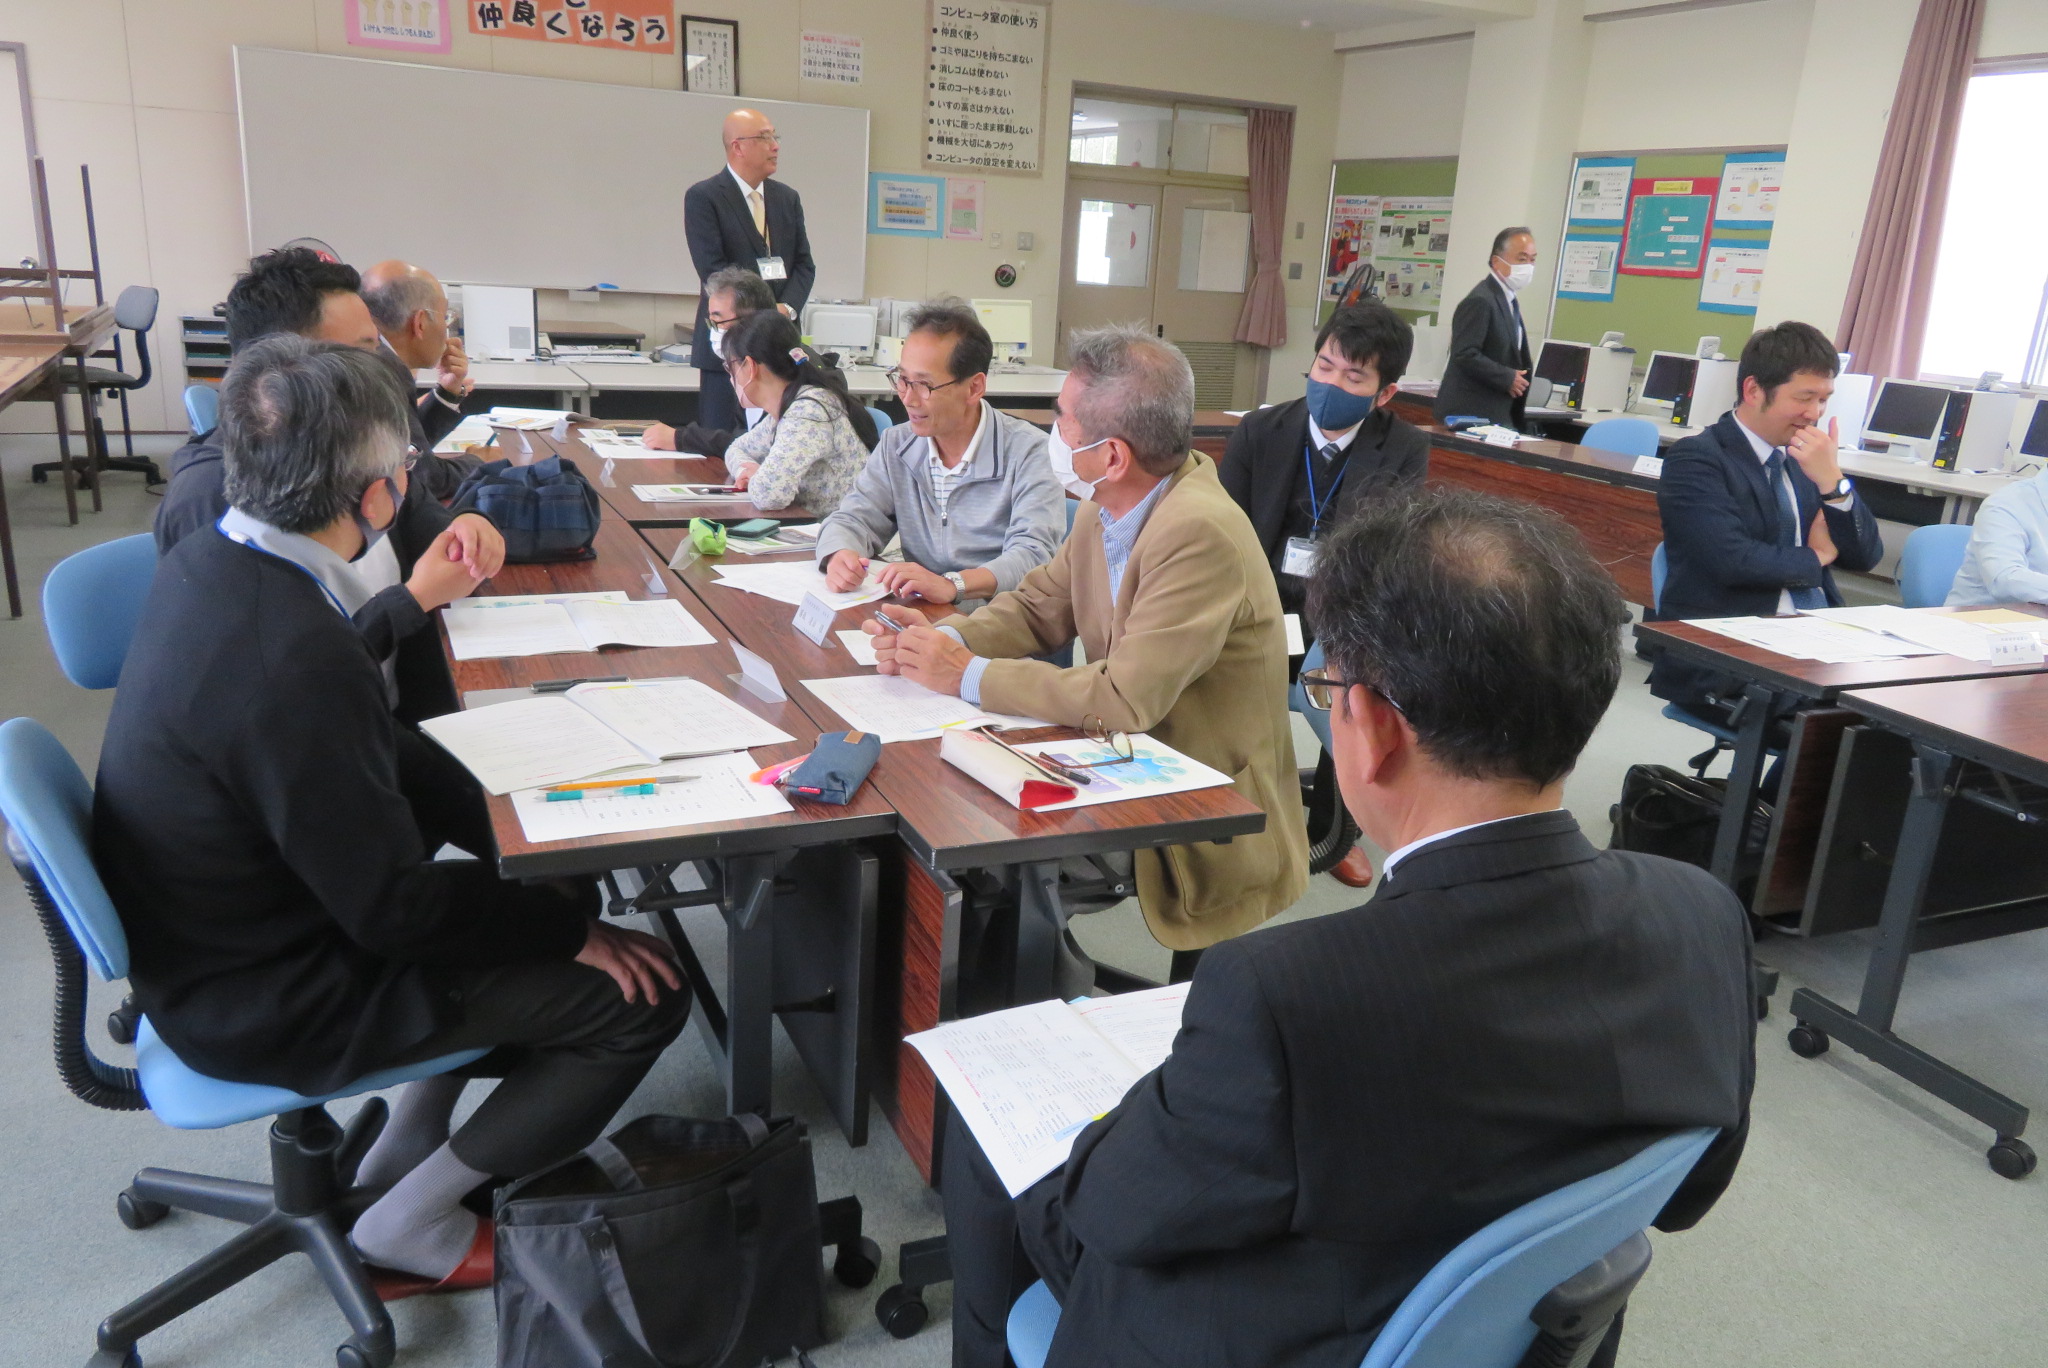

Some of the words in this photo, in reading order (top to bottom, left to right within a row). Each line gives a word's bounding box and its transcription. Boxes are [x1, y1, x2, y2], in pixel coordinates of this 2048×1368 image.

[478, 0, 666, 42] 仲良くなろう
[940, 6, 1039, 29] コンピュータ室の使い方
[941, 27, 979, 41] 仲良く使う
[940, 46, 1033, 65] ゴミやほこりを持ちこまない
[939, 64, 1009, 79] 消しゴムは使わない
[938, 82, 1012, 97] 床のコードをふまない
[937, 101, 1015, 115] いすの高さはかえない
[936, 118, 1033, 135] いすに座ったまま移動しない
[936, 135, 1014, 150] 機械を大切にあつかう
[935, 153, 1036, 170] コンピュータの設定を変えない
